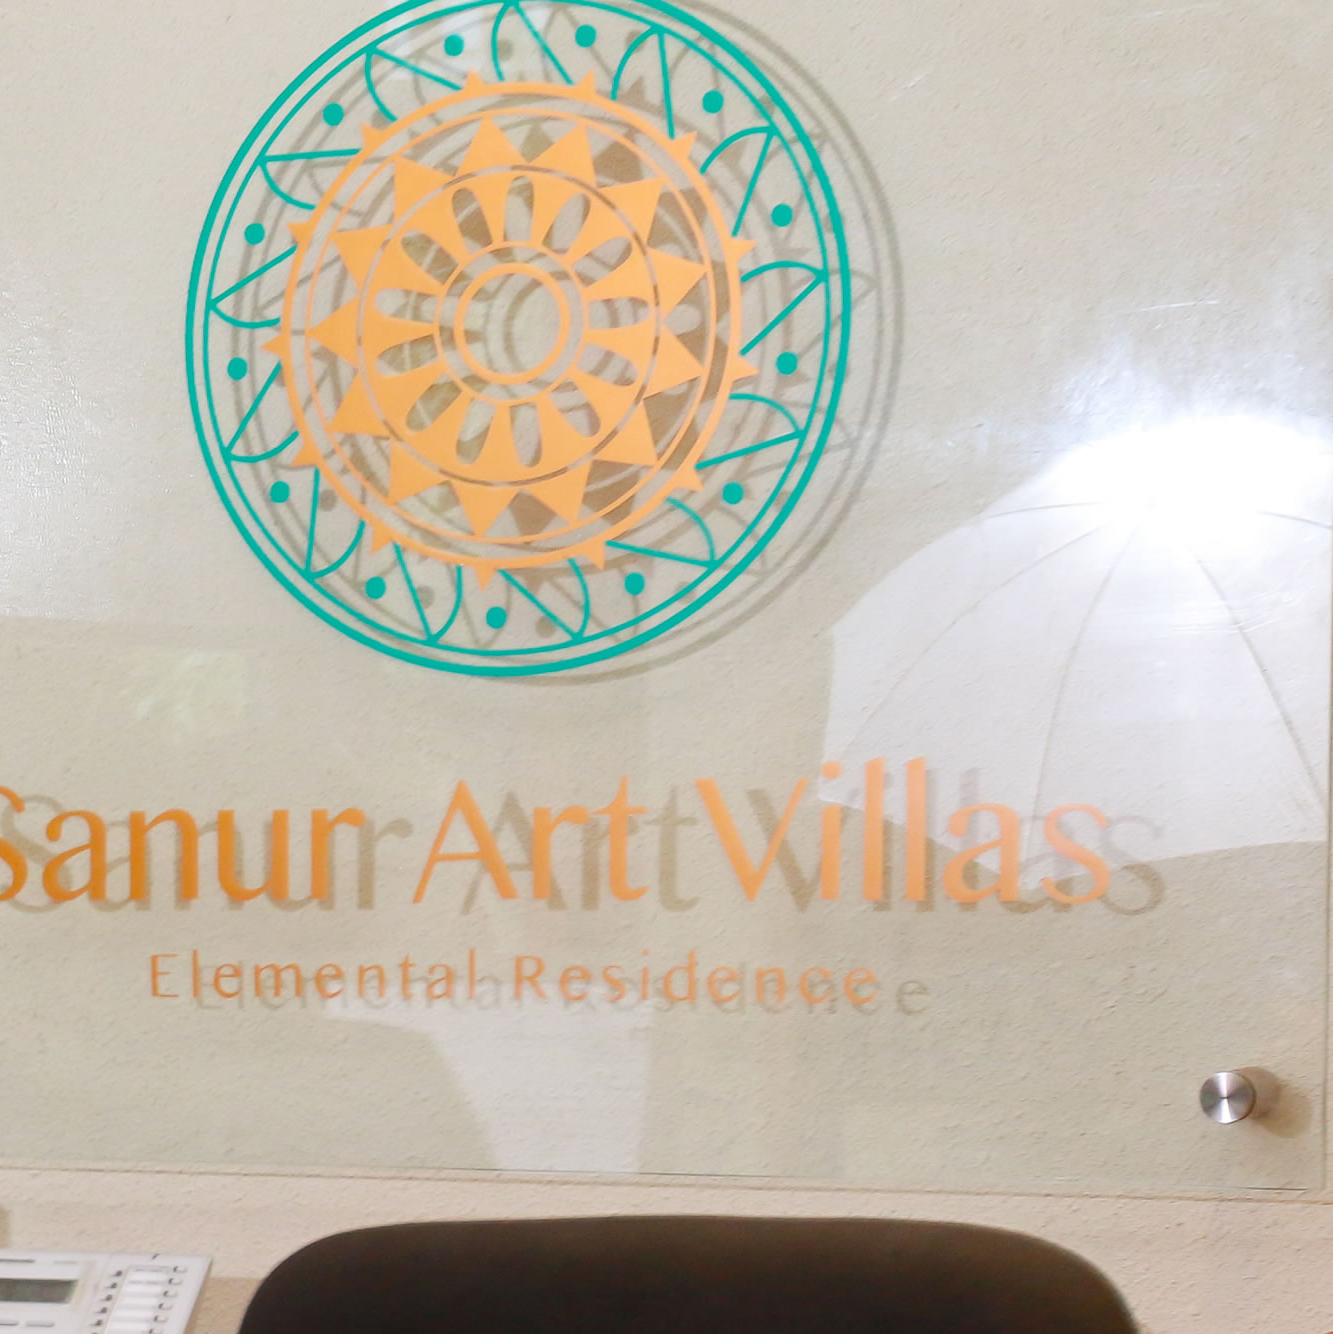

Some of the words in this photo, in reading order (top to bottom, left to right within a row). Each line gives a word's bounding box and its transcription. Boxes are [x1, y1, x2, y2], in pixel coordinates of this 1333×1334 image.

[412, 775, 650, 904] Art
[694, 756, 1112, 905] Villas
[150, 947, 476, 1000] Elemental
[515, 947, 879, 1005] Residence
